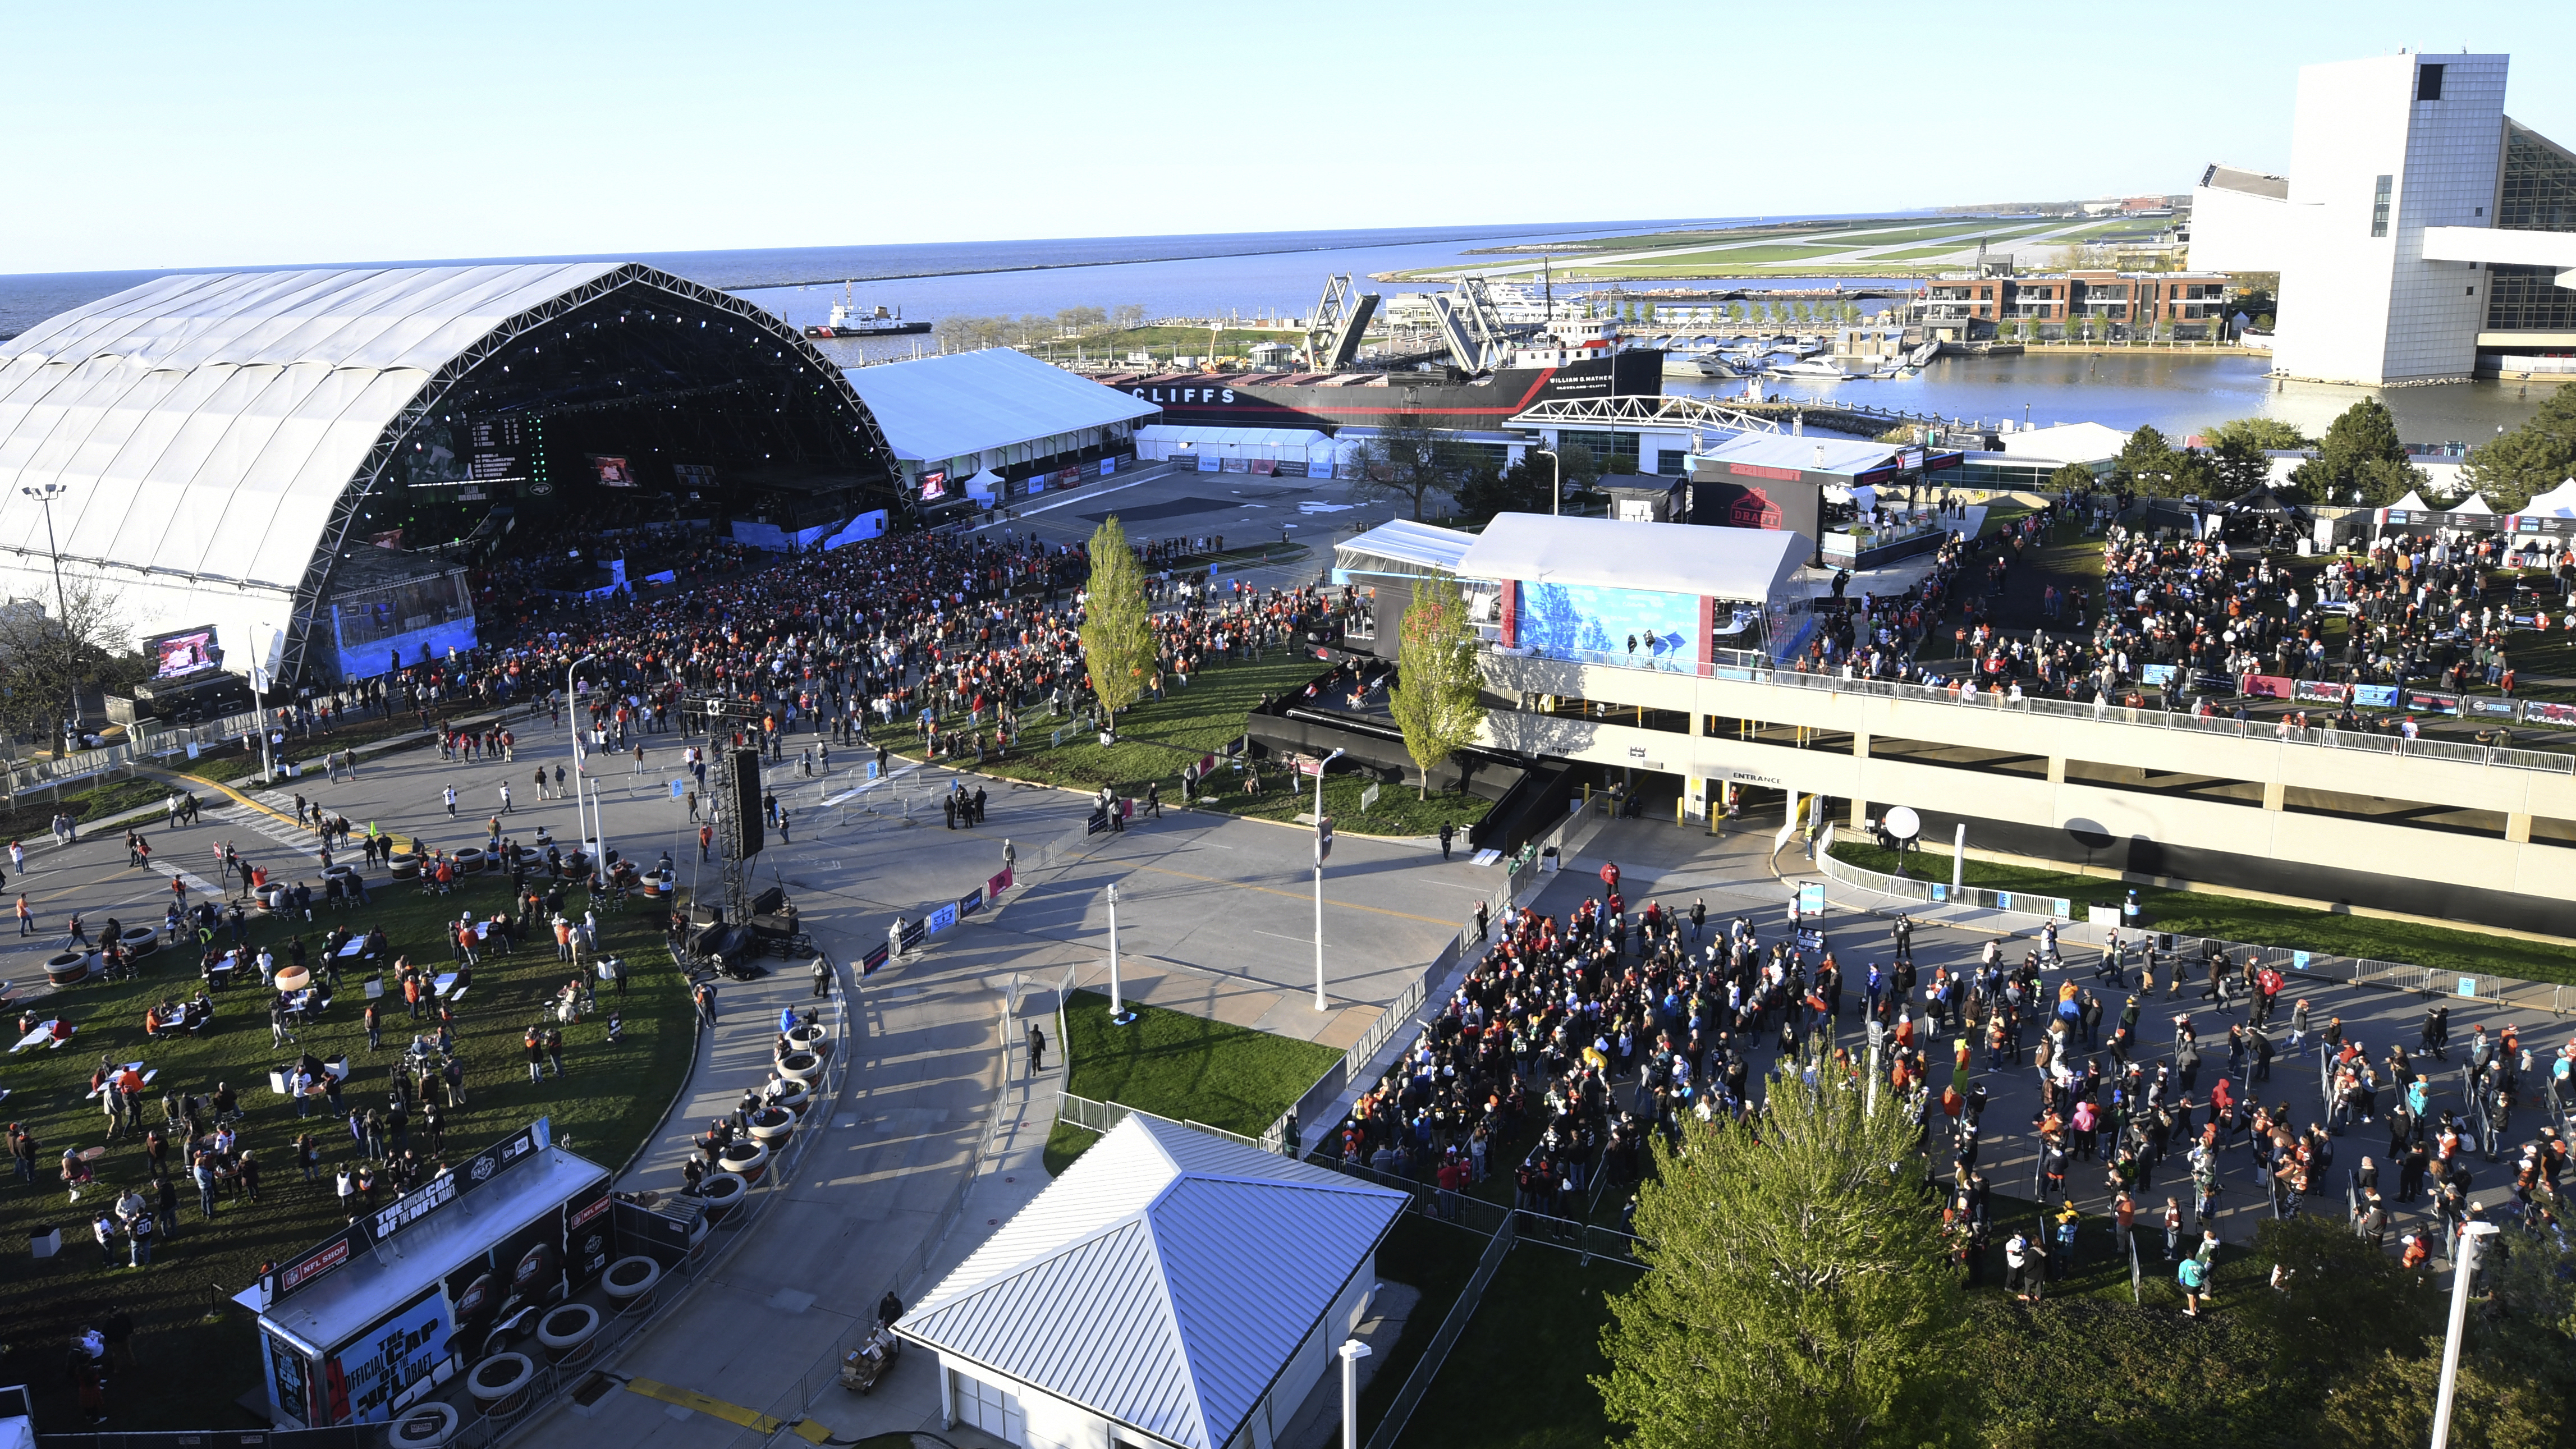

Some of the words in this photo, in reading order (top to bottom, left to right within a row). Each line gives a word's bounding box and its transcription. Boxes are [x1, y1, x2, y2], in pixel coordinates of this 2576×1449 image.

[1133, 388, 1234, 403] CLIFFS
[1734, 510, 1777, 525] DRAFT
[1733, 772, 1781, 784] ENTRANCE
[297, 1080, 303, 1089] 6
[473, 1162, 494, 1177] DRAFT
[376, 1203, 404, 1225] THE
[403, 1190, 426, 1212] OFFICIAL
[425, 1173, 455, 1198] CAP
[584, 1208, 595, 1218] NFL
[595, 1199, 609, 1212] SHOP
[377, 1220, 397, 1238] OF
[399, 1210, 410, 1226] THE
[410, 1198, 439, 1221] NFL
[438, 1184, 456, 1204] DRAFT
[136, 1221, 152, 1235] 80
[303, 1259, 322, 1274] NFL
[322, 1245, 346, 1265] SHOP
[377, 1328, 405, 1352] THE
[345, 1352, 386, 1393] OFFICIAL
[386, 1318, 438, 1366] CAP
[379, 1363, 398, 1383] OF
[399, 1355, 409, 1370] THE
[357, 1373, 404, 1418] NFL
[404, 1351, 432, 1387] DRAFT
